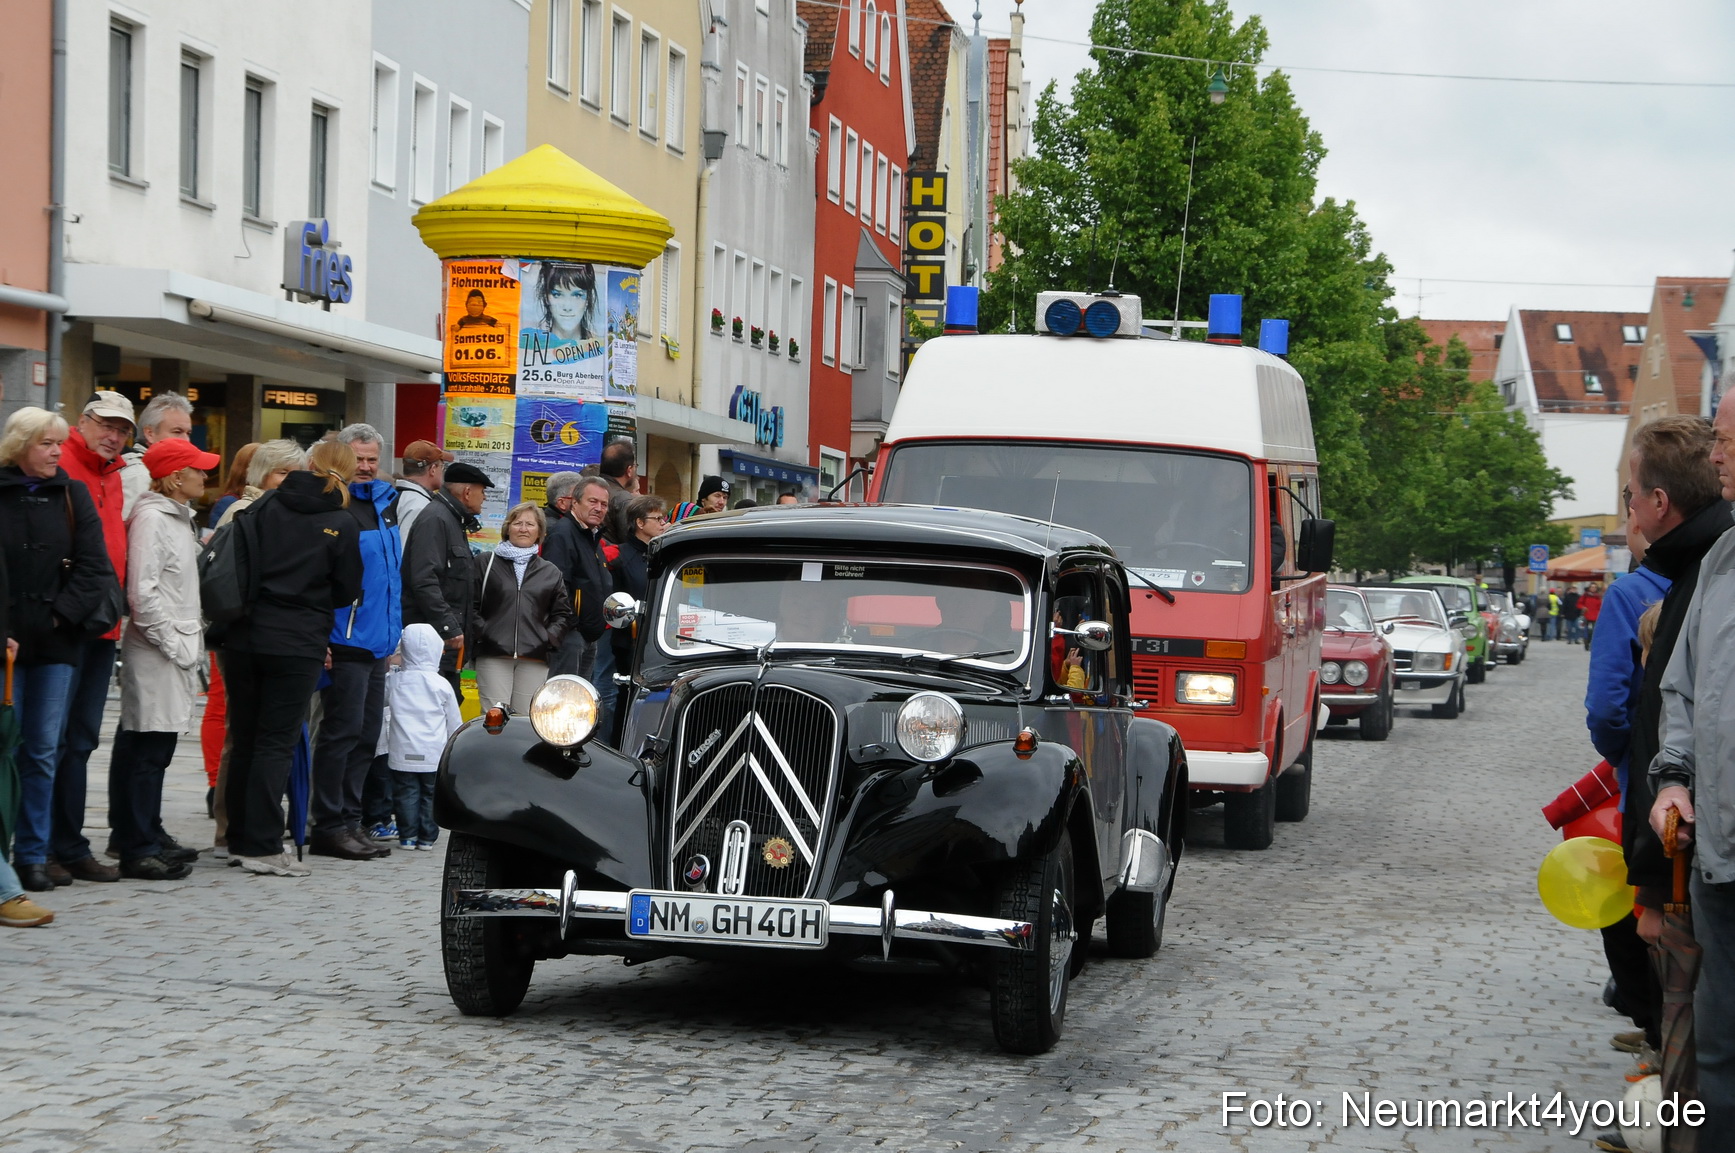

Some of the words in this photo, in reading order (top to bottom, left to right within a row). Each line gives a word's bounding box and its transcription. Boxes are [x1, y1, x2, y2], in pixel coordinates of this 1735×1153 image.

[299, 217, 353, 304] fries
[451, 265, 503, 275] Neumarkt
[907, 177, 945, 371] HOTE
[451, 277, 517, 289] Flohmarkt
[454, 333, 505, 345] Samstag
[454, 348, 502, 361] 01.06.
[521, 332, 552, 368] ZAZ
[555, 345, 585, 364] OPEN
[588, 340, 603, 359] AIR
[447, 372, 510, 385] Volksfestplatz
[522, 369, 557, 382] 25.6.
[556, 371, 573, 380] Burg
[556, 378, 575, 387] Open
[489, 385, 511, 394] 7-14h
[264, 390, 319, 406] FRIES
[445, 440, 466, 450] Sonntag,
[467, 440, 474, 449] 2.
[475, 440, 490, 449] Juni
[491, 441, 511, 451] 2013
[683, 568, 704, 576] ADAC
[834, 564, 850, 572] Bitte
[1146, 639, 1169, 653] 31
[636, 917, 645, 927] D
[650, 901, 691, 932] NM
